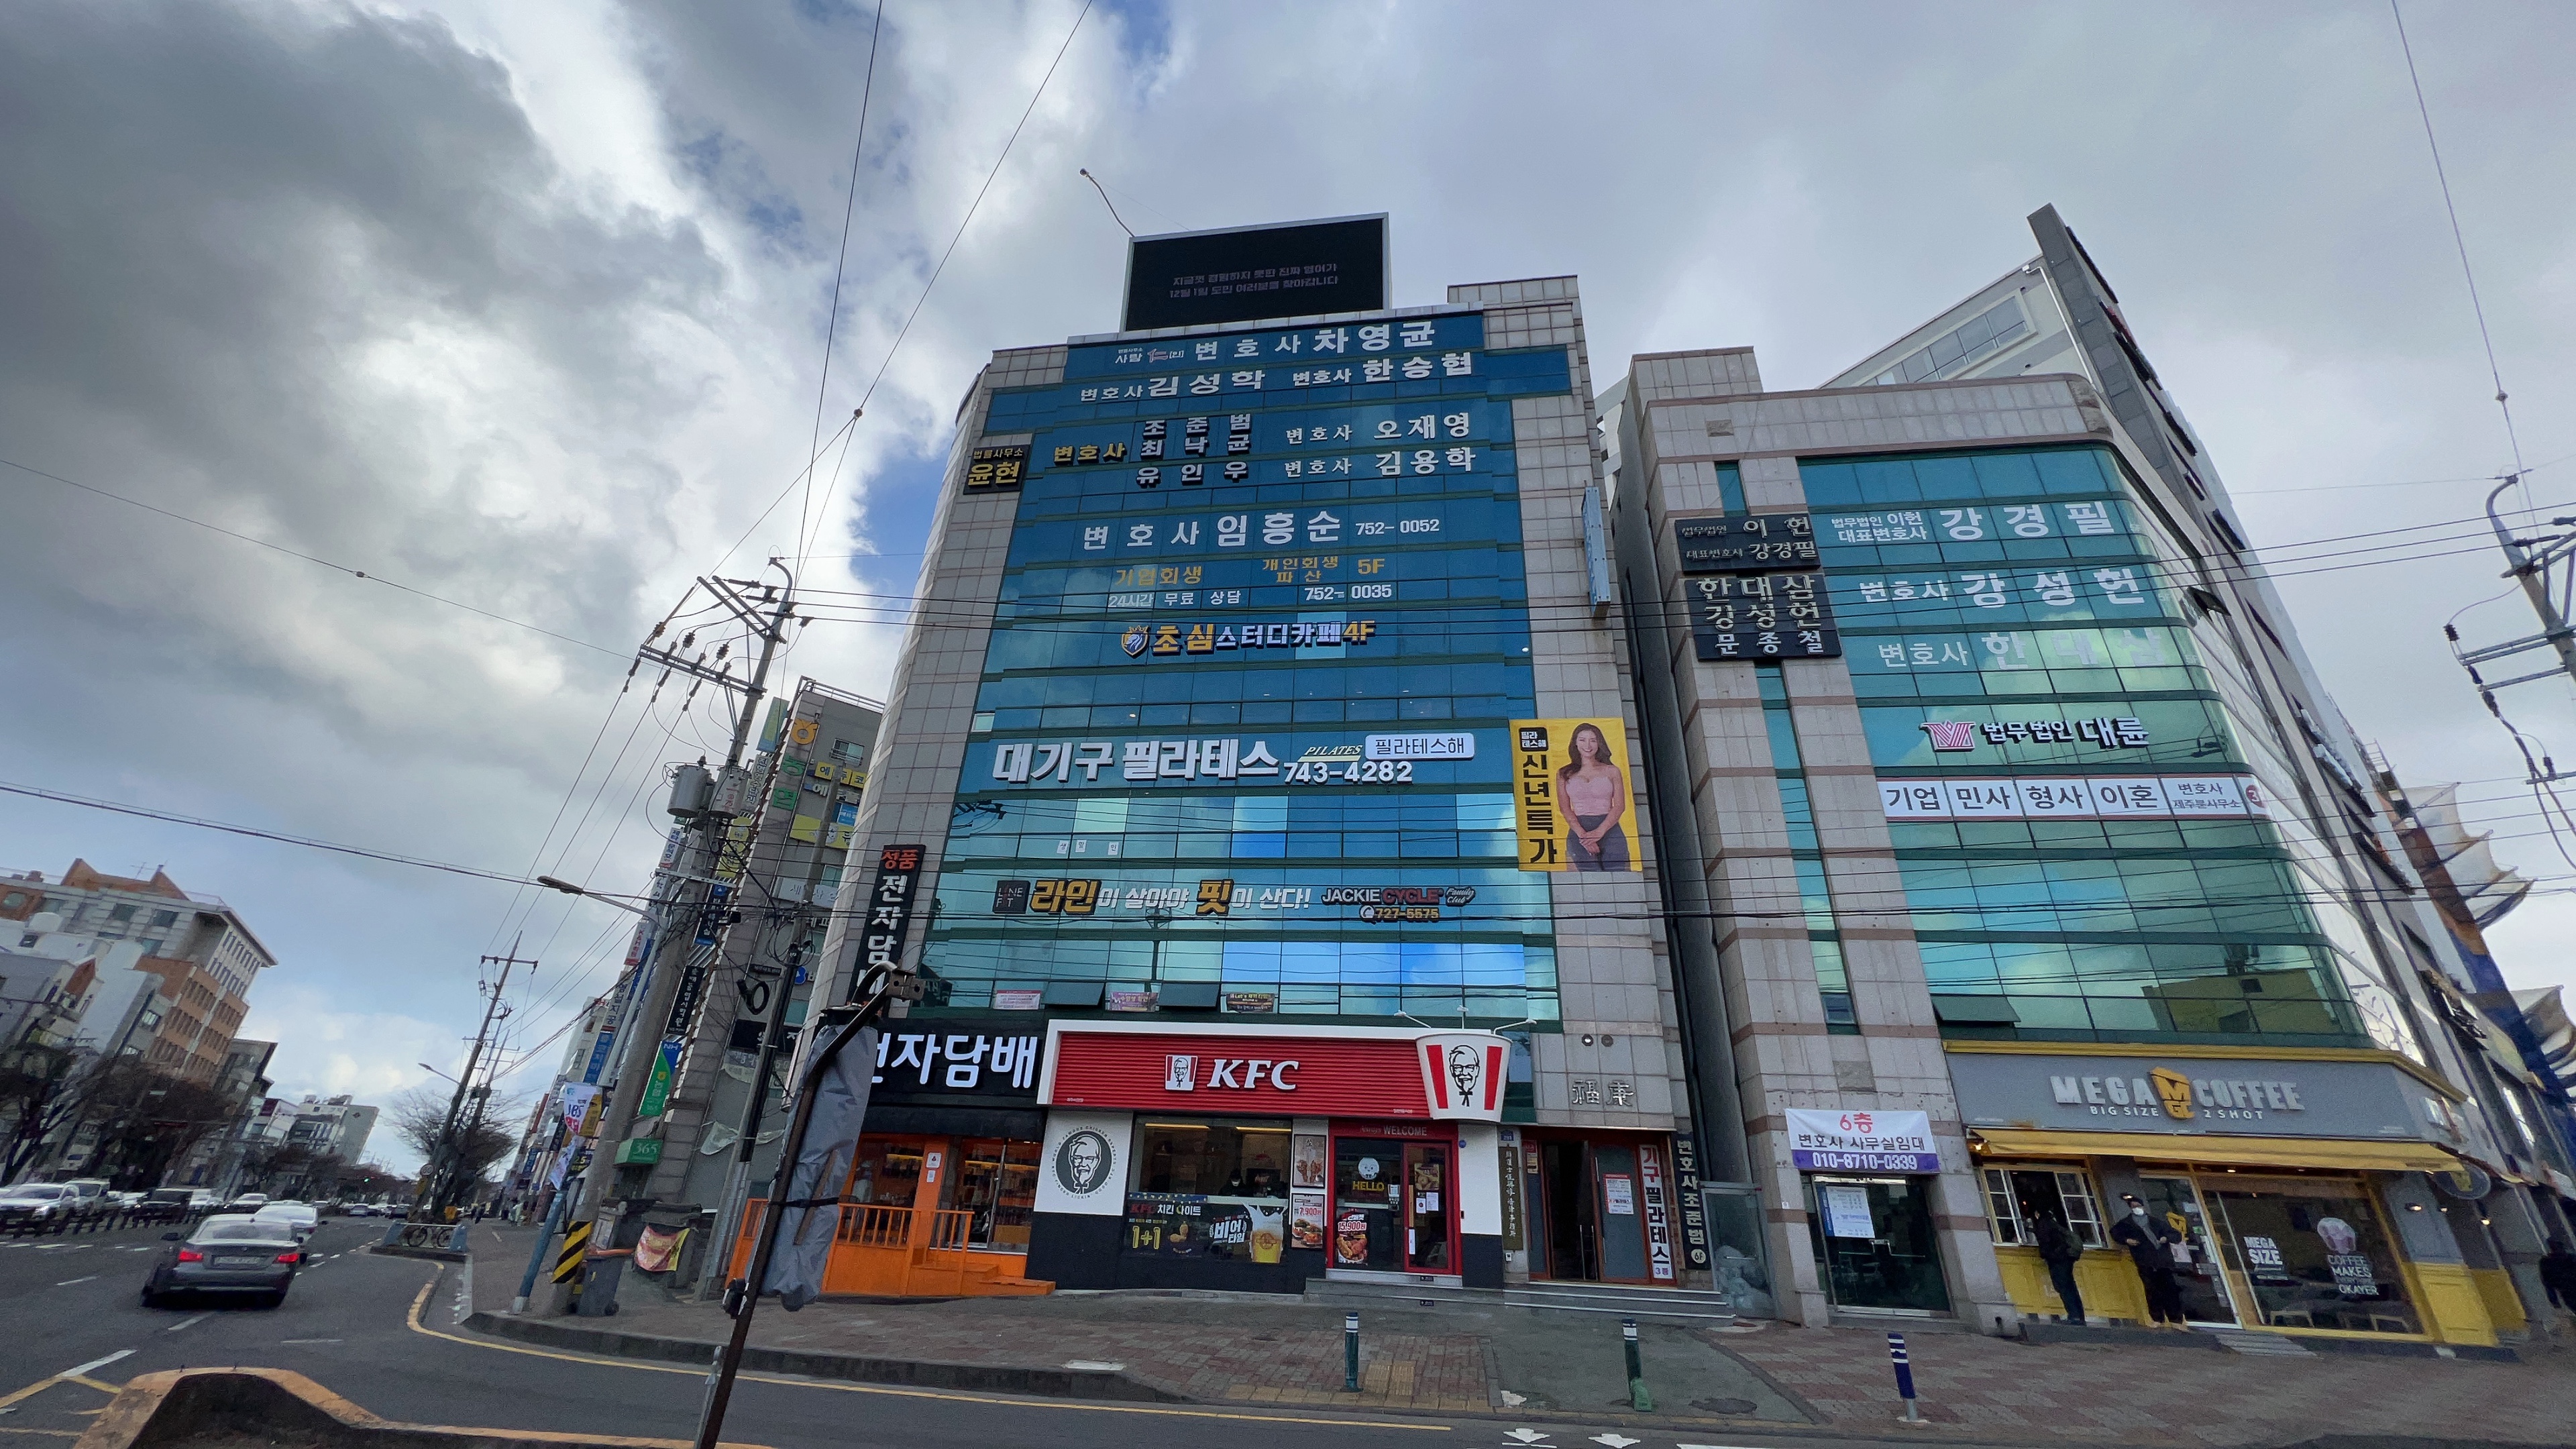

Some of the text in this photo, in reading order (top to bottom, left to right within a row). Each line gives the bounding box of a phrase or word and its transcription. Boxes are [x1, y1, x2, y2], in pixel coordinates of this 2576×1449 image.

[1195, 320, 1435, 362] 변호사 차영균
[1115, 353, 1142, 364] 사람
[1081, 352, 1472, 402] 변호사 김성학 변호사 한승협
[1144, 413, 1251, 437] 조준범
[1286, 412, 1470, 445] 변호사 오재영
[973, 447, 1023, 460] 법률사무소
[1054, 443, 1125, 463] 변호사
[1142, 434, 1250, 457] 최낙균
[1284, 447, 1476, 478] 변호사 김용학
[968, 461, 1020, 486] 윤현
[1136, 461, 1248, 485] 유인우
[1084, 521, 1199, 550] 변호사
[1216, 510, 1341, 547] 임흥순
[1831, 517, 1882, 528] 법무법인
[1940, 500, 2114, 541] 강경필
[1682, 525, 1727, 537] 법무법인
[1838, 526, 1927, 543] 대표변호사
[1686, 541, 1817, 560] 대표변호사 강경필
[1262, 555, 1385, 575] 개인회생 5F
[1115, 566, 1202, 587] 기업회생
[1697, 576, 1815, 602] 한대삼
[1859, 568, 2145, 608] 변호사 강성헌
[1108, 594, 1154, 609] 24시간
[1164, 591, 1194, 606] 무료
[1210, 590, 1241, 605] 상담
[1705, 602, 1821, 631] 강성헌
[1715, 631, 1823, 655] 문종철
[1878, 641, 1968, 668] 변호사
[1521, 731, 1538, 739] 필라
[1982, 716, 2149, 748] 법무법인 대륜
[1303, 744, 1362, 757] PILATES
[1375, 737, 1465, 756] 필라테스해
[1521, 739, 1546, 748] 테스해
[991, 739, 1279, 784] 대기구 필라테스
[1284, 761, 1413, 784] 743-4282
[1886, 784, 2157, 810] 기업 민사 형사 이혼
[2178, 783, 2222, 795] 변호사
[2173, 799, 2241, 808] 제주분사무소
[881, 849, 918, 870] 정품
[1029, 879, 1311, 915] 라인이 살아야 핏이 산다!
[1322, 888, 1439, 903] JACKIE CYCLE
[1446, 888, 1474, 899] Family
[1376, 908, 1438, 919] 727-5575
[1207, 1059, 1299, 1091] KFC
[2050, 1076, 2157, 1106] MEGA
[2195, 1079, 2305, 1111] COFFEE
[1840, 1112, 1872, 1133] 6층
[2090, 1106, 2264, 1120] BIG SIZE 2 SHOT
[1383, 1126, 1428, 1136] WELCOME
[633, 1142, 659, 1155] 365
[1799, 1134, 1925, 1151] 변호사 사무실임대
[1813, 1152, 1917, 1170] 010-8710-0339
[1352, 1181, 1385, 1191] HELLO
[1130, 1205, 1201, 1216] KFC 치킨 나이트
[1641, 1146, 1671, 1265] 기구필라테스
[1132, 1225, 1161, 1250] 1+1
[1214, 1219, 1242, 1239] 비어
[1228, 1232, 1245, 1244] 타임
[2244, 1236, 2277, 1249] MEGA
[1694, 1252, 1704, 1261] 6F
[2248, 1248, 2283, 1265] SIZE
[2328, 1255, 2366, 1265] COFFEE
[2332, 1267, 2372, 1278] MAKES
[2339, 1284, 2379, 1295] OKAYER
